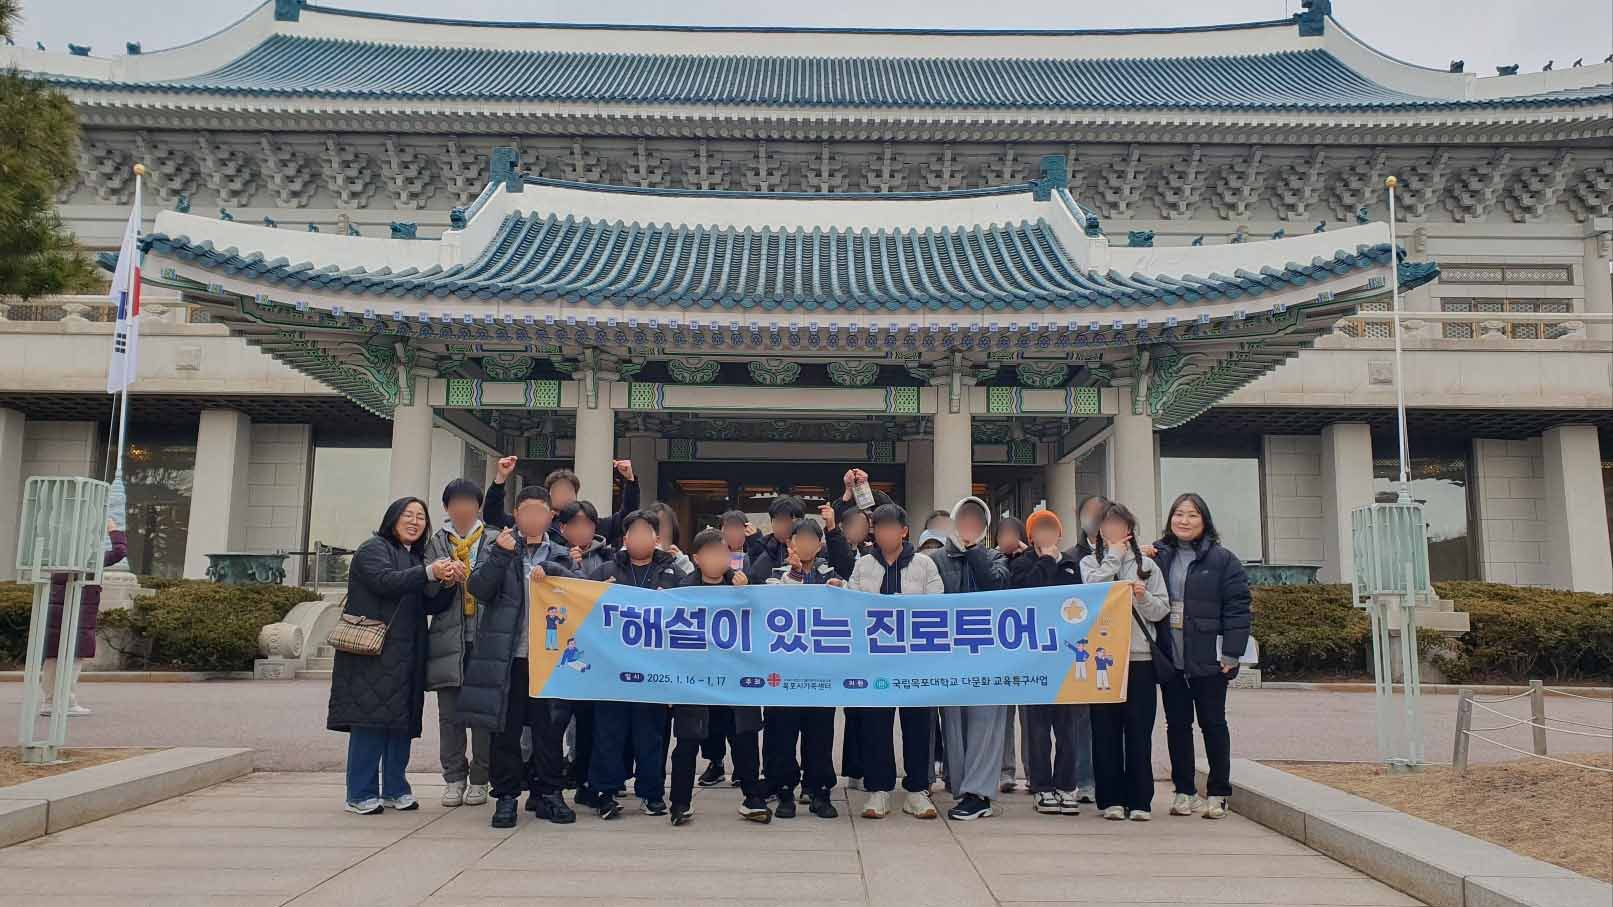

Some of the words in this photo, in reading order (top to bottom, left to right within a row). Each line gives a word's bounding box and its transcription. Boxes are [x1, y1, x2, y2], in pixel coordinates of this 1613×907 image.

[602, 604, 752, 652] 「해설이
[766, 608, 851, 653] 있는
[866, 607, 1058, 654] 진로투어」
[647, 673, 673, 683] 2025.
[717, 676, 726, 687] 17
[892, 678, 959, 689] 국립목포대학교
[962, 677, 991, 687] 다문화
[994, 675, 1048, 687] 교육특구사업
